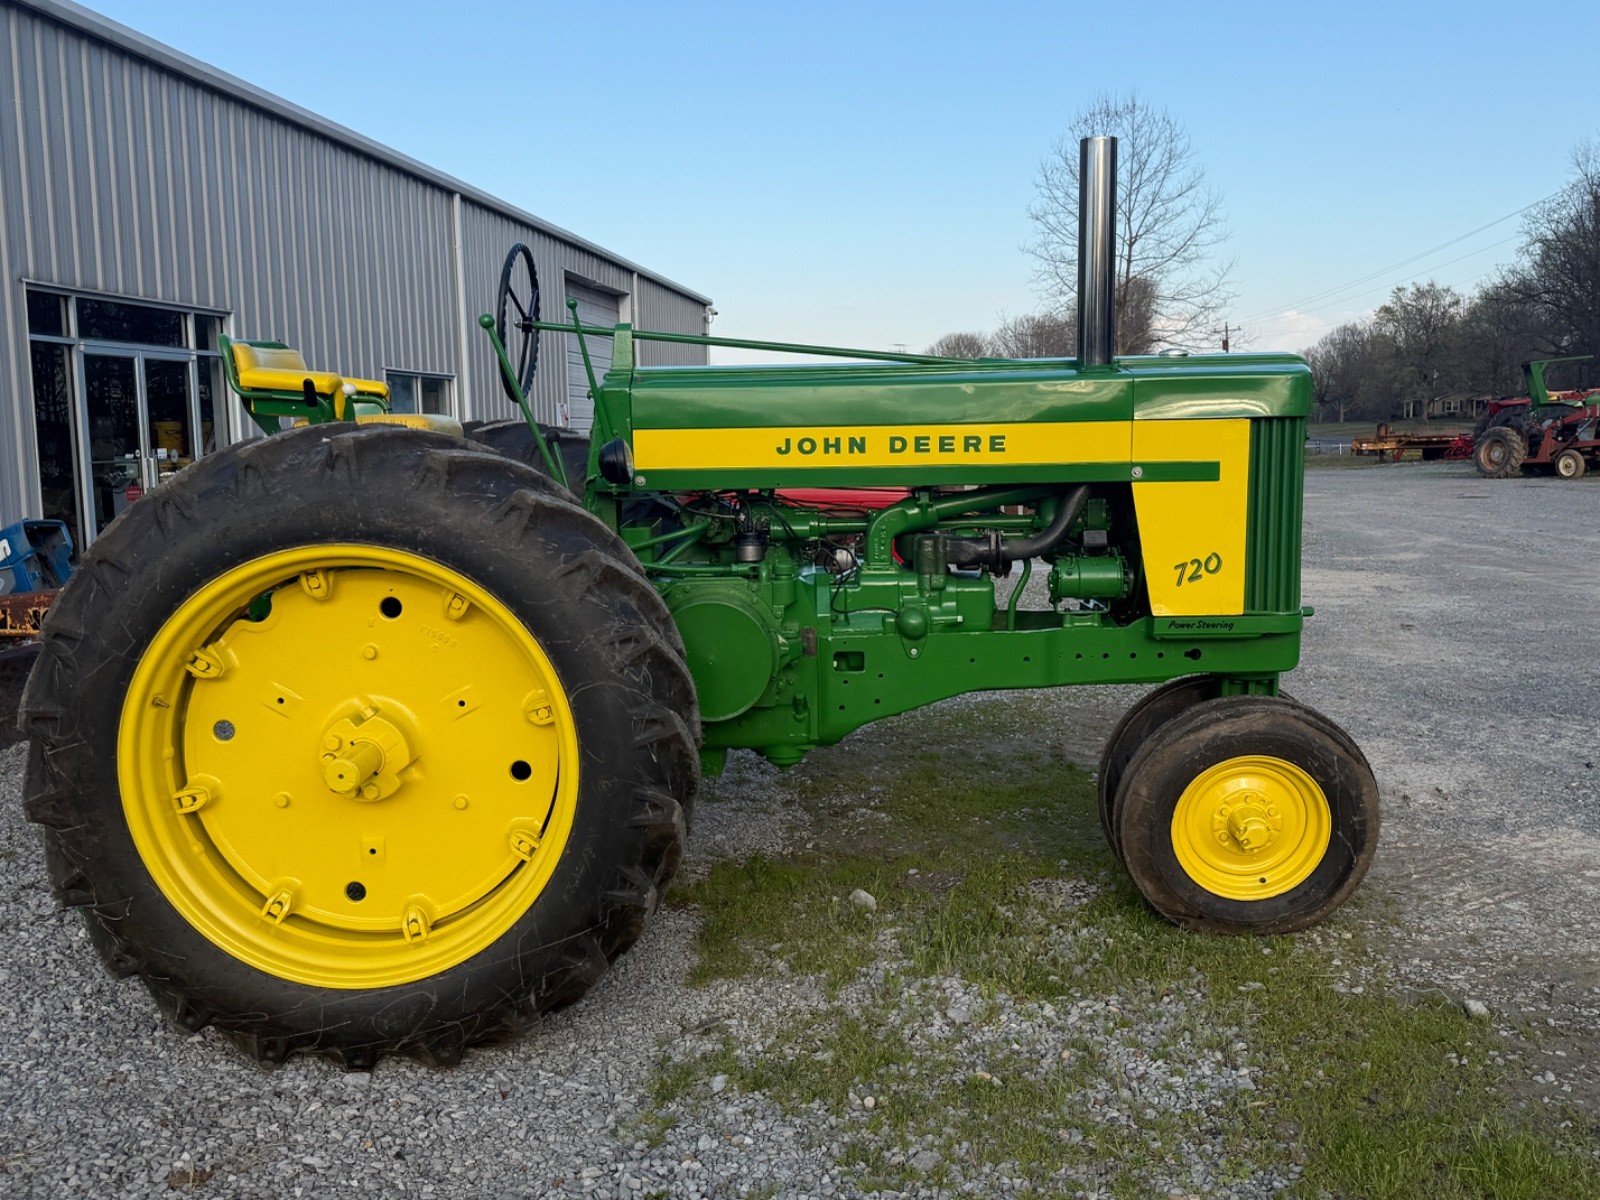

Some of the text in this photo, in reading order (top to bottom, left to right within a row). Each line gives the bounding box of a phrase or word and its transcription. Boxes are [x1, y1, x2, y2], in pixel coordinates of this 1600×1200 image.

[776, 435, 1006, 455] JOHN DEERE
[1174, 552, 1222, 587] 720
[1168, 620, 1234, 631] Power Steering
